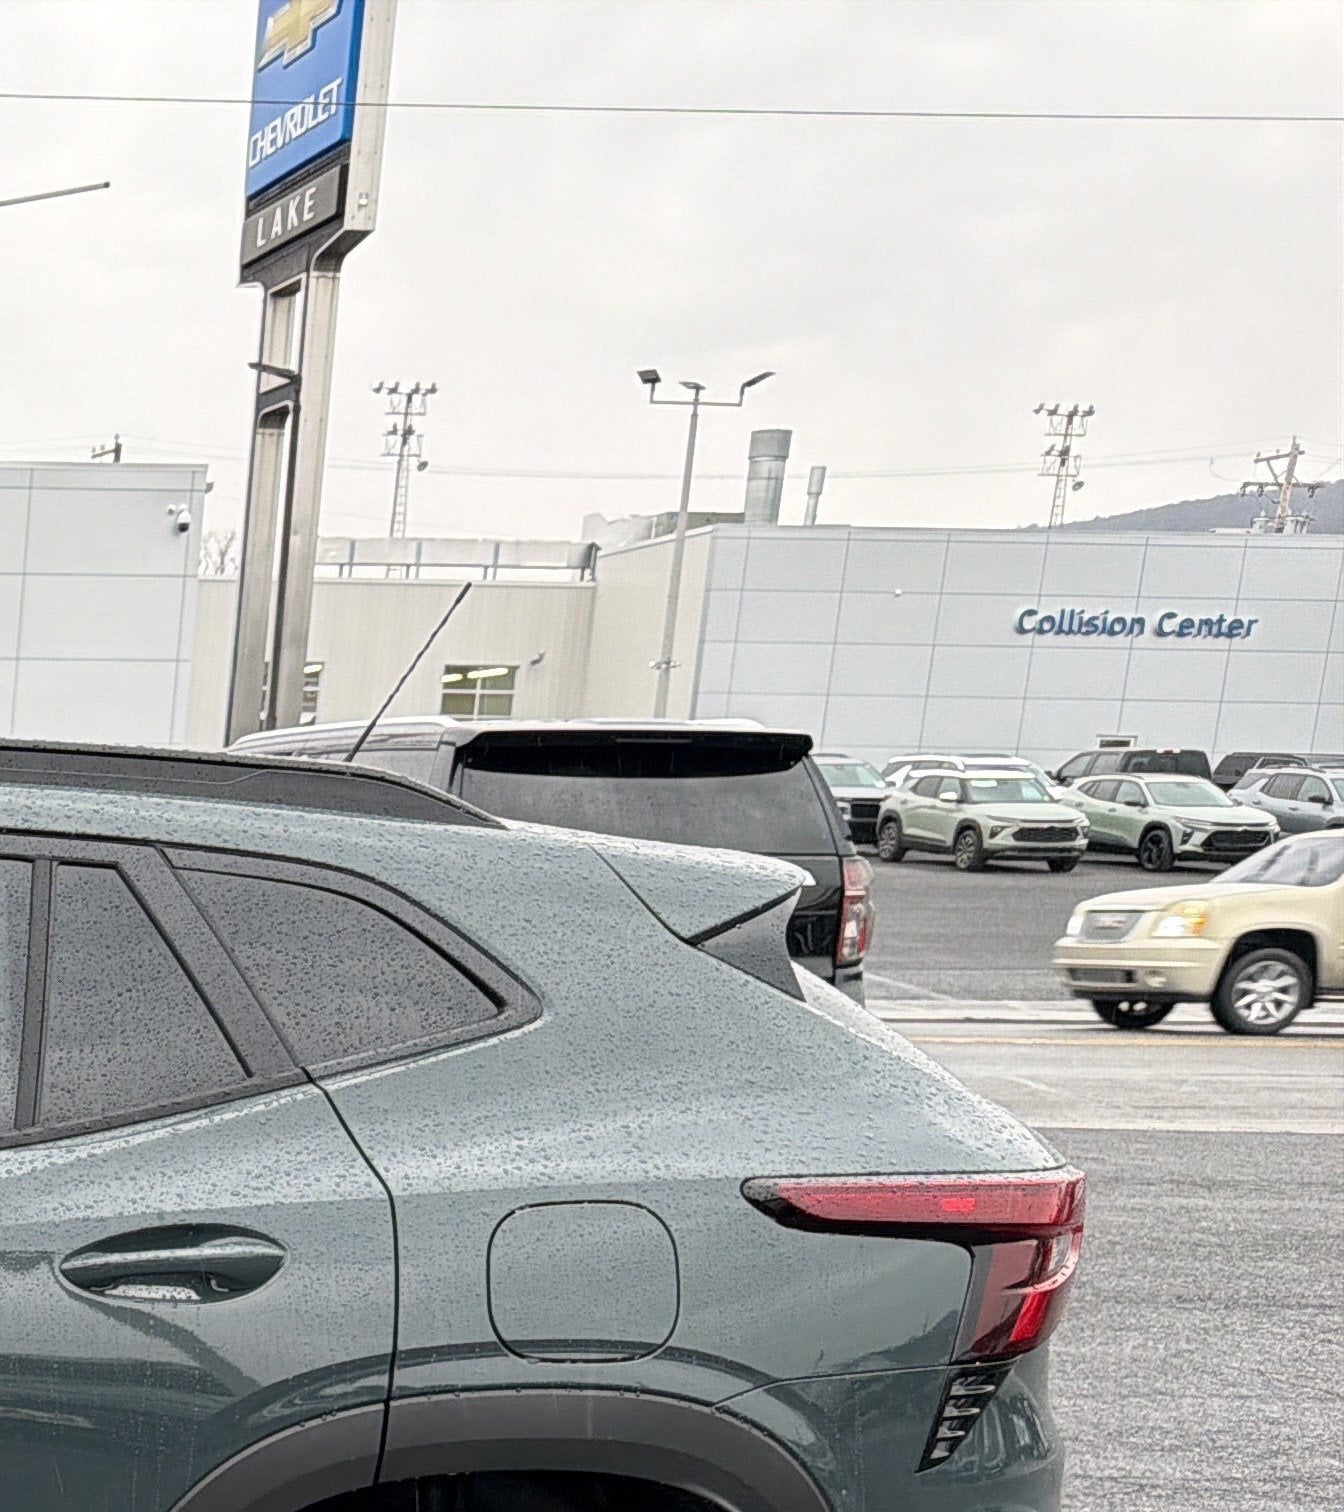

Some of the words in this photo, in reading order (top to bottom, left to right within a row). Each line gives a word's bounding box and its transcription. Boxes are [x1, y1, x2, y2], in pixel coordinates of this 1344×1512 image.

[249, 77, 343, 168] CHEVROLET
[256, 187, 317, 247] LAKE
[1015, 608, 1146, 637] Collision
[1154, 611, 1259, 639] Center
